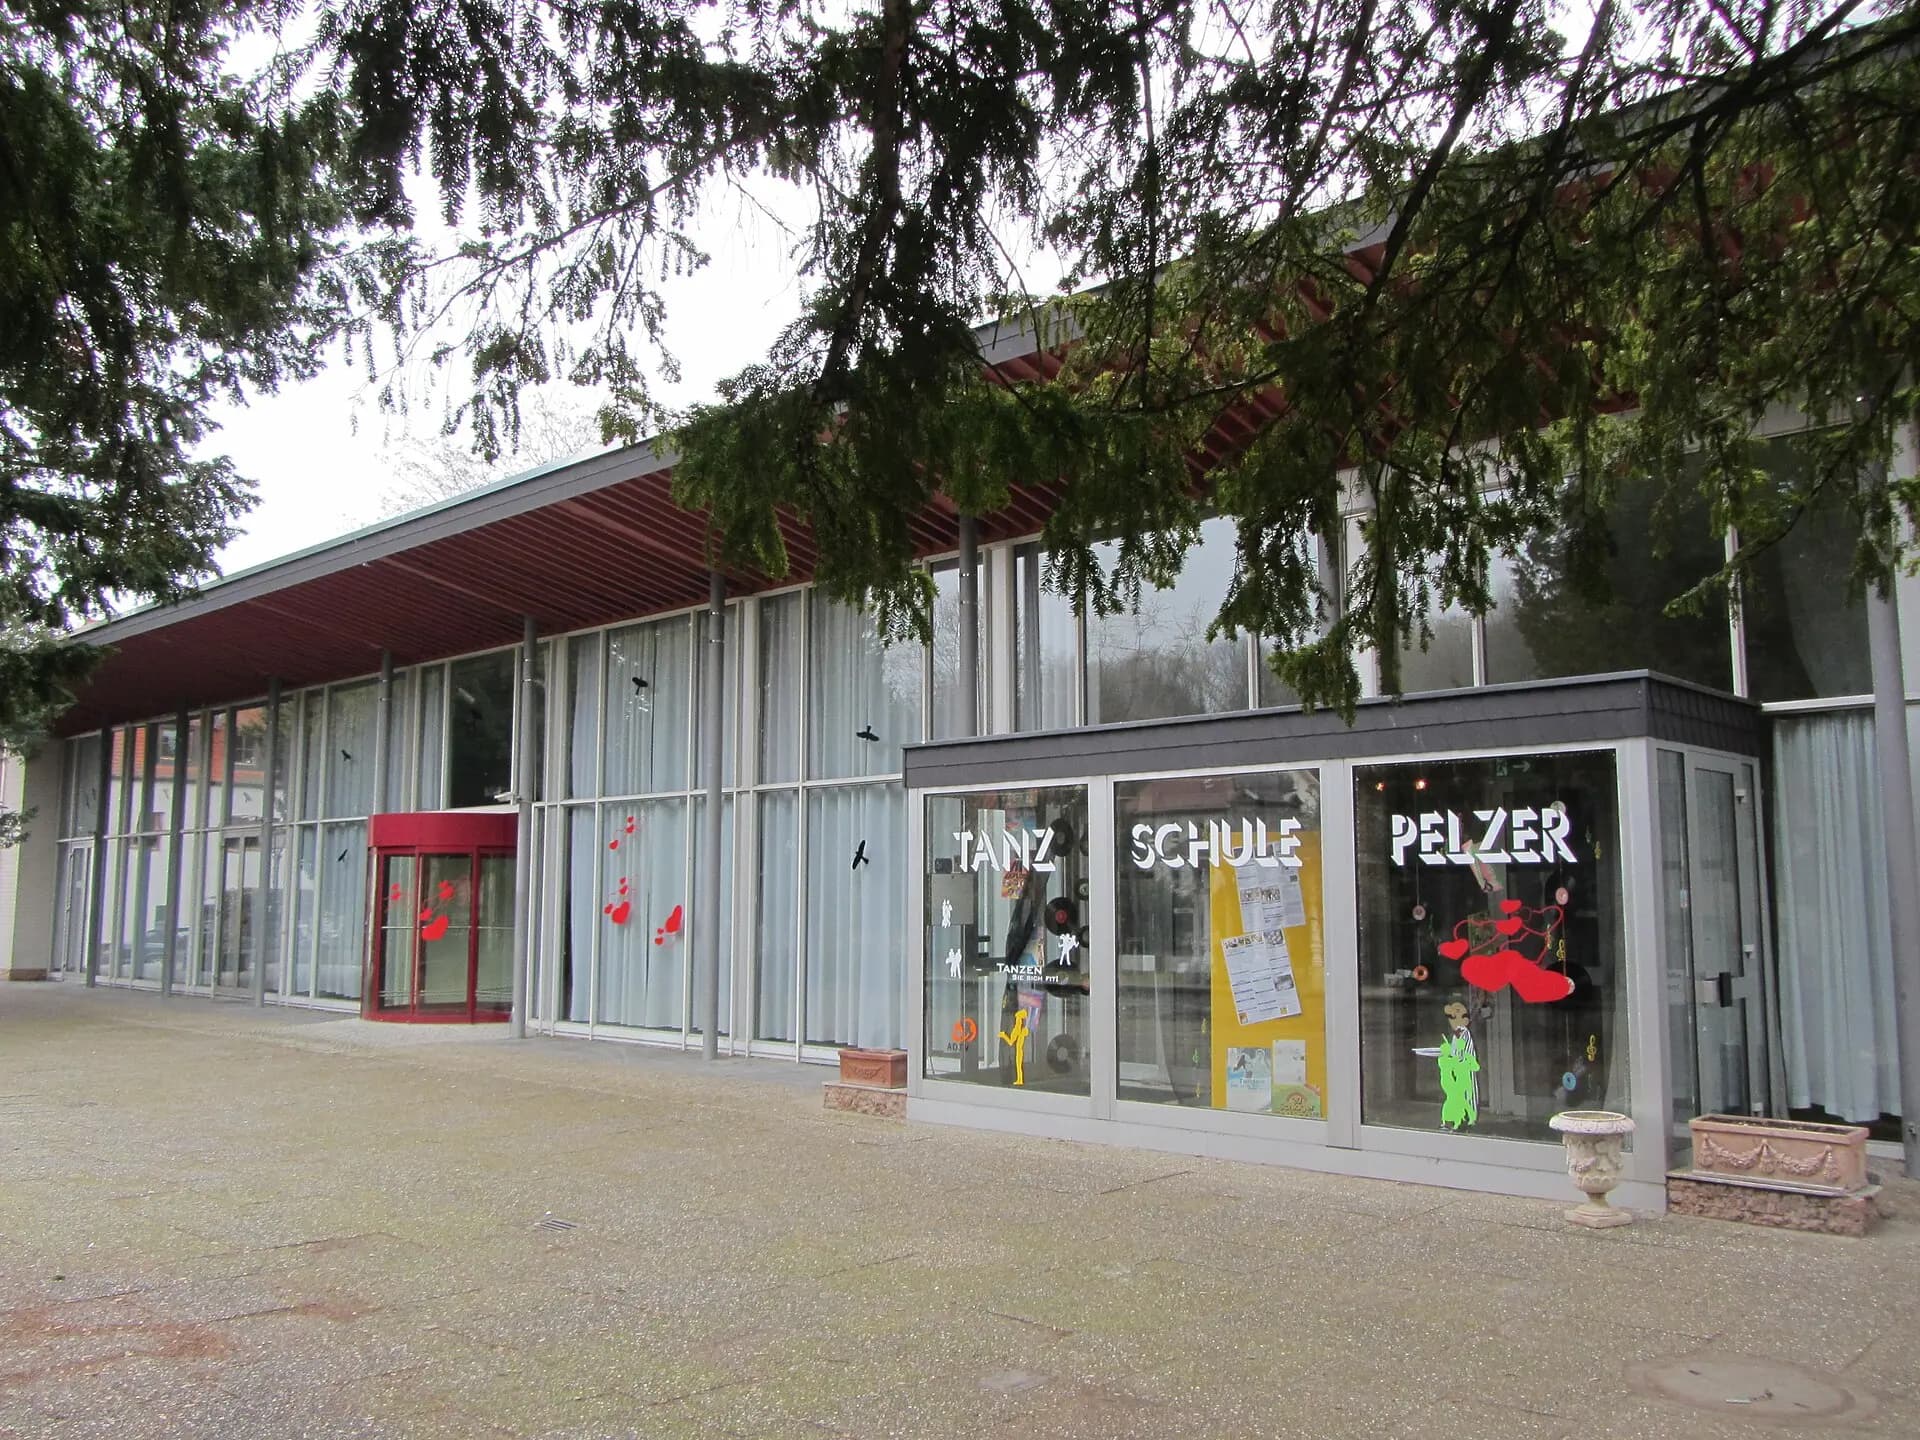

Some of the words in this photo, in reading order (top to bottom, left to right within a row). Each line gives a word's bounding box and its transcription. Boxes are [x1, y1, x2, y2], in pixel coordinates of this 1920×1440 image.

[953, 827, 1056, 872] TANZ
[1131, 816, 1303, 869] SCHULE
[1391, 806, 1578, 866] PELZER
[996, 962, 1043, 975] TANZEN
